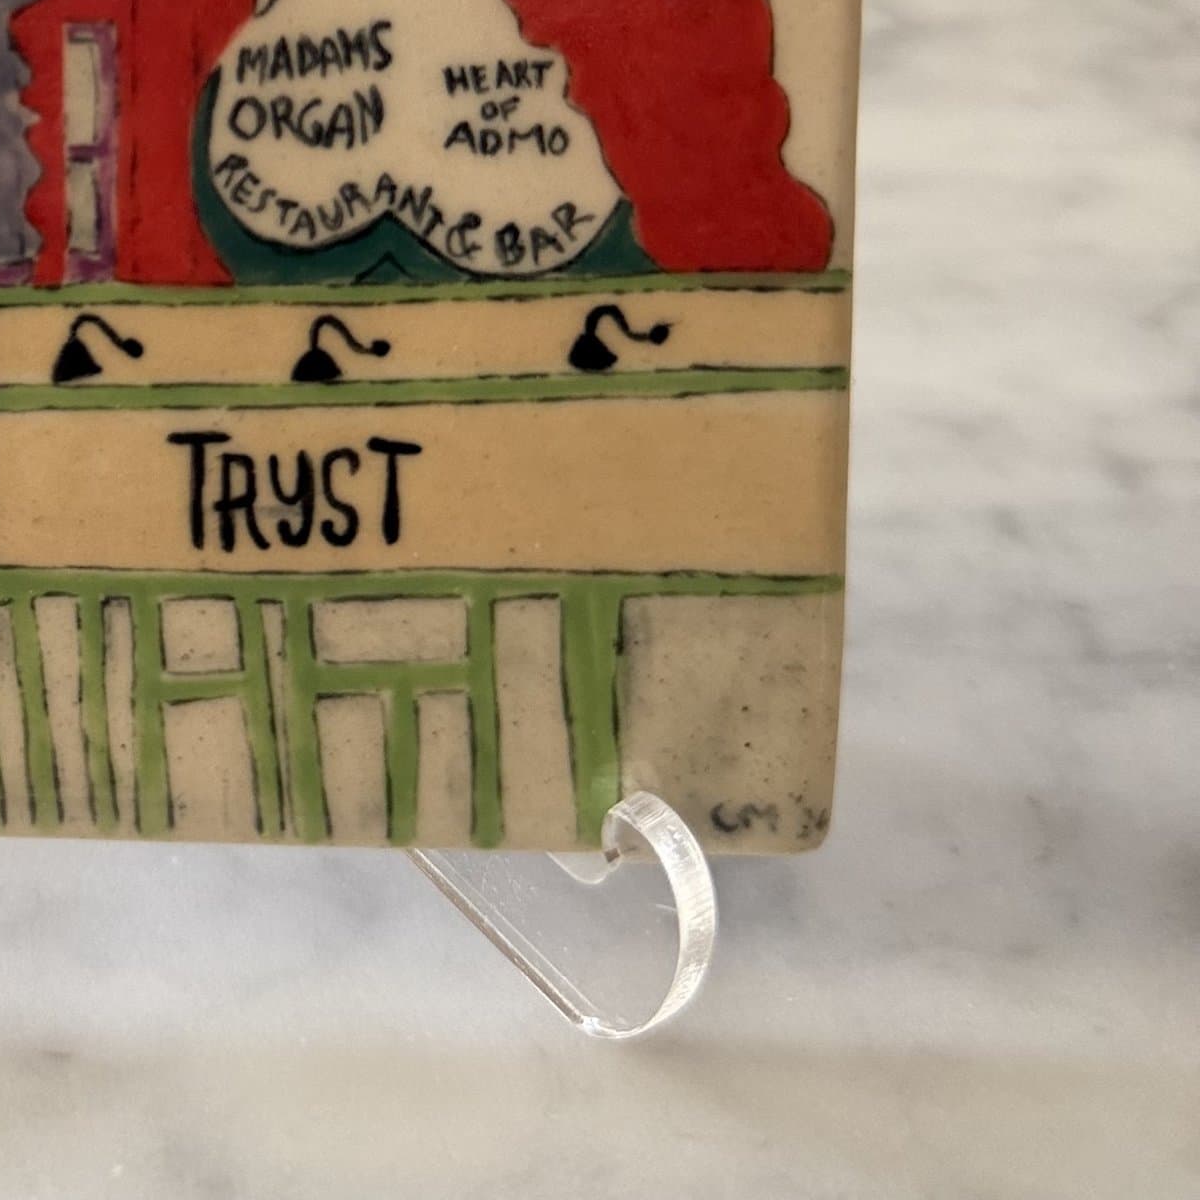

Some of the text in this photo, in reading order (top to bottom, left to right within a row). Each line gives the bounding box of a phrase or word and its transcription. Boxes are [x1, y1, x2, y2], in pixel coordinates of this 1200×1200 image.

[237, 21, 394, 84] MADAMS
[443, 60, 554, 96] HEART
[229, 85, 385, 150] ORGAN
[444, 121, 571, 157] ADMO
[481, 97, 520, 122] OF
[214, 153, 446, 242] RESTAURANT
[495, 202, 596, 269] BAR
[167, 431, 423, 552] TRYST
